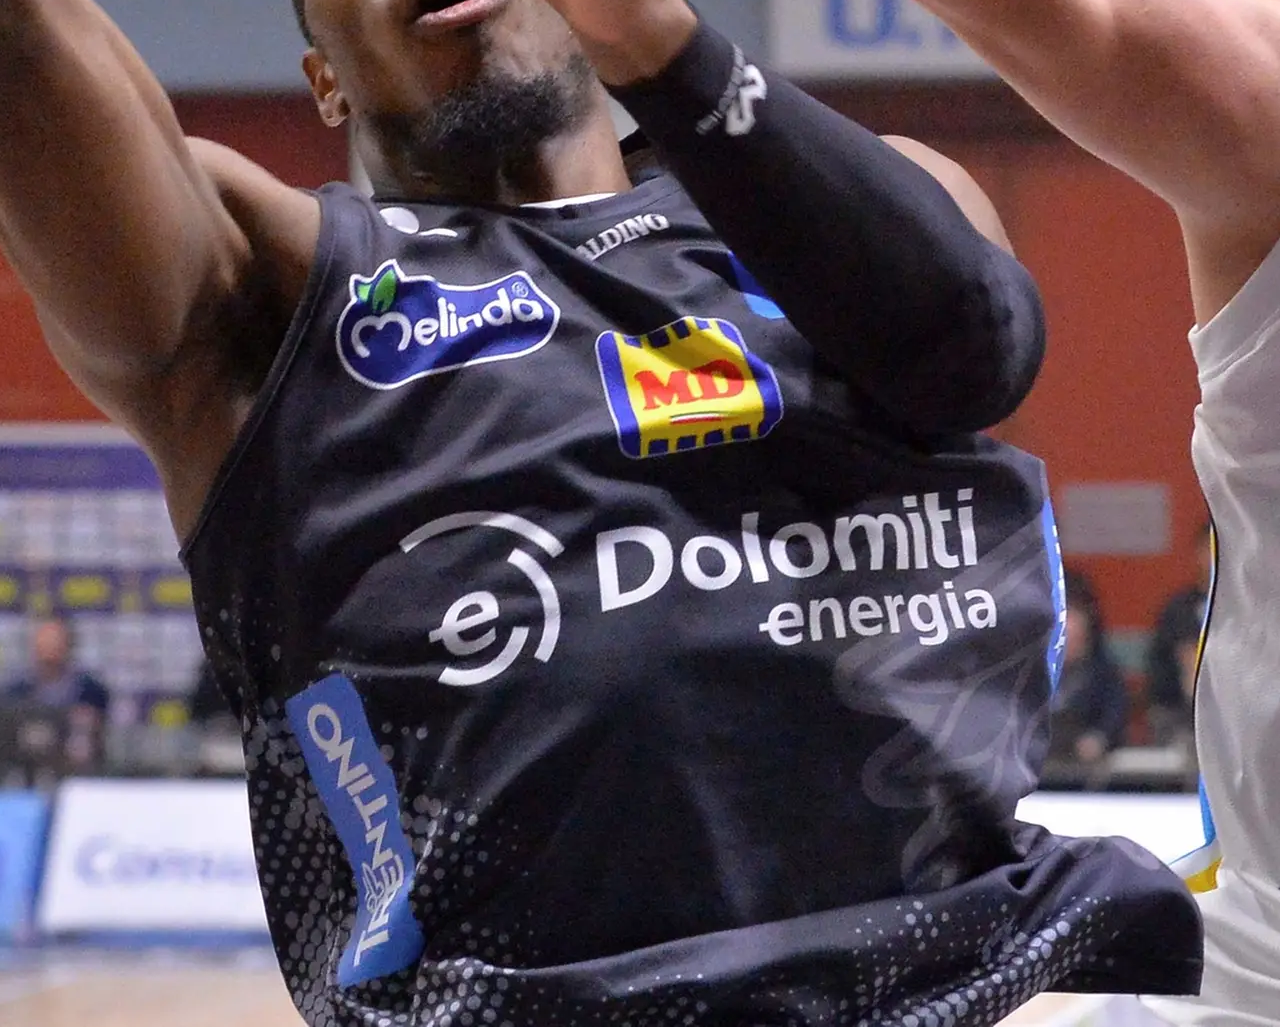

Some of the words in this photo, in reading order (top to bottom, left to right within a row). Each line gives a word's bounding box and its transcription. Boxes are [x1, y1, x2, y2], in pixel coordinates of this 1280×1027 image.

[576, 212, 671, 262] ALDING
[350, 287, 545, 359] Melinda
[633, 358, 745, 411] MD
[595, 488, 979, 612] Dolomiti
[758, 580, 998, 646] energia
